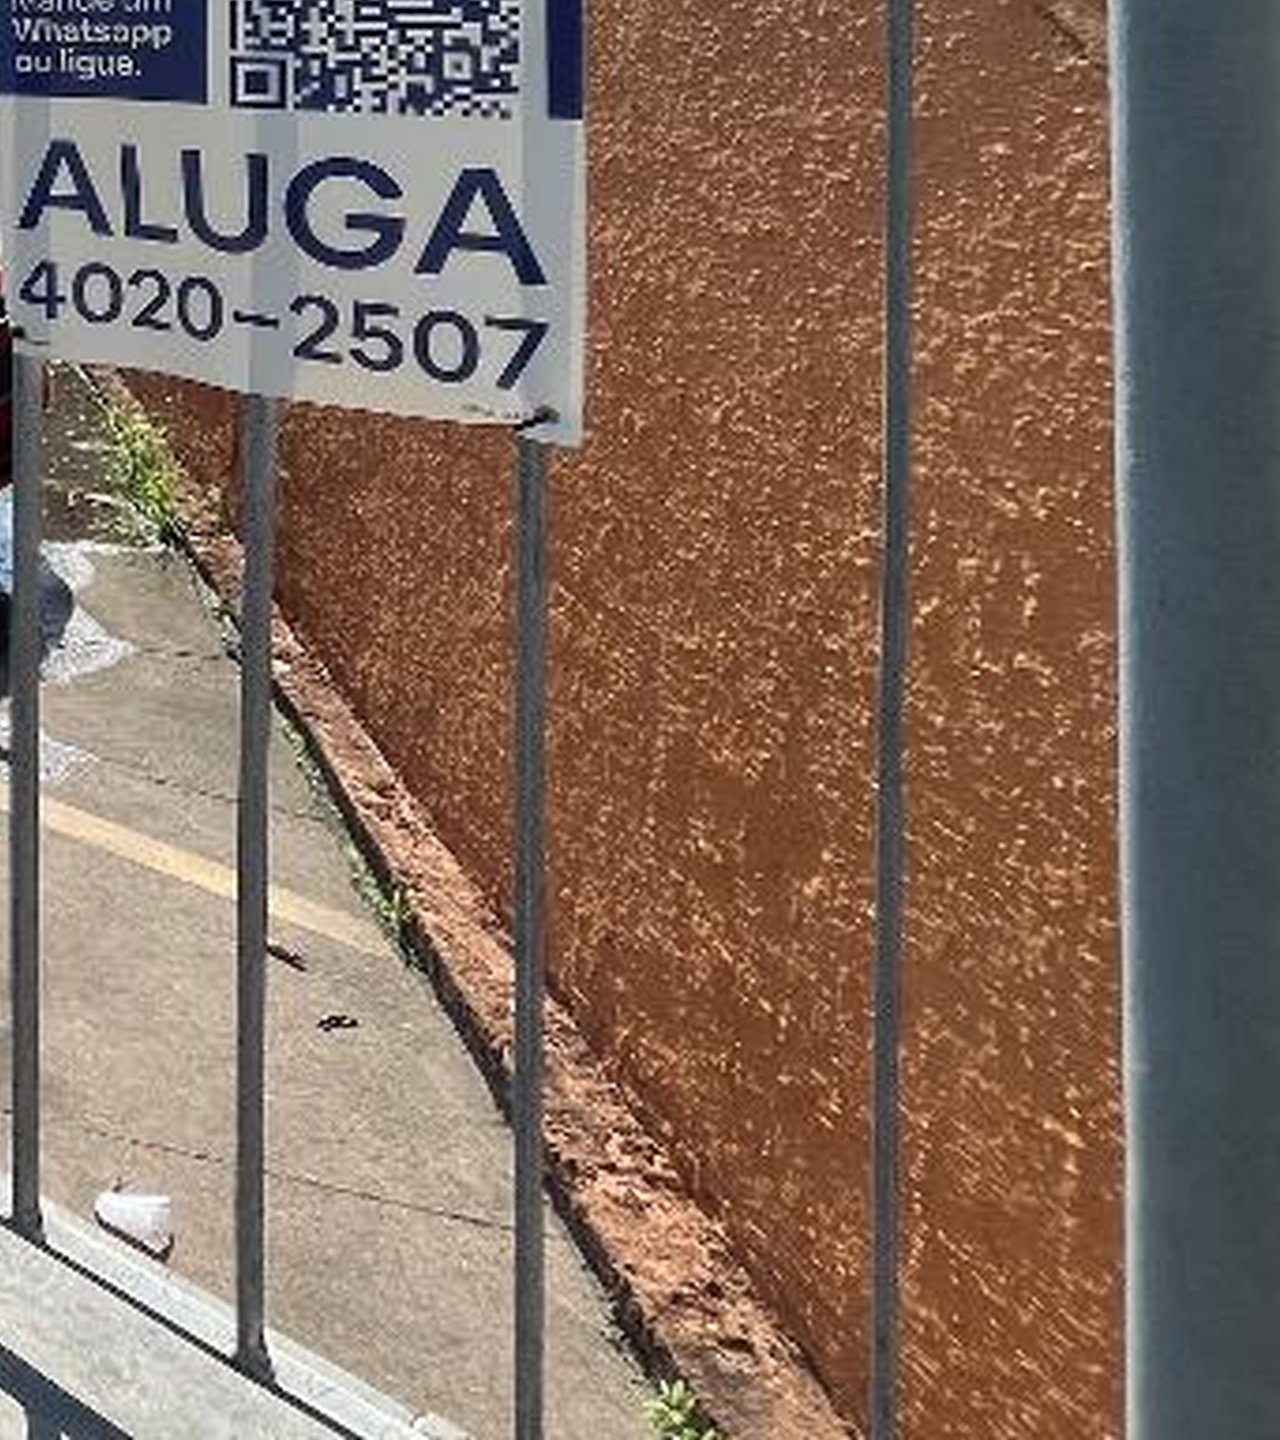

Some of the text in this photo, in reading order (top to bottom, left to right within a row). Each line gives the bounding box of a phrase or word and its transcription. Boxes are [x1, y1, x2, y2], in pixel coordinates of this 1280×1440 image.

[11, 17, 172, 50] Whatsapp
[15, 47, 142, 80] ou ligue.
[17, 139, 548, 287] ALUGA
[18, 259, 550, 391] 4020-2507
